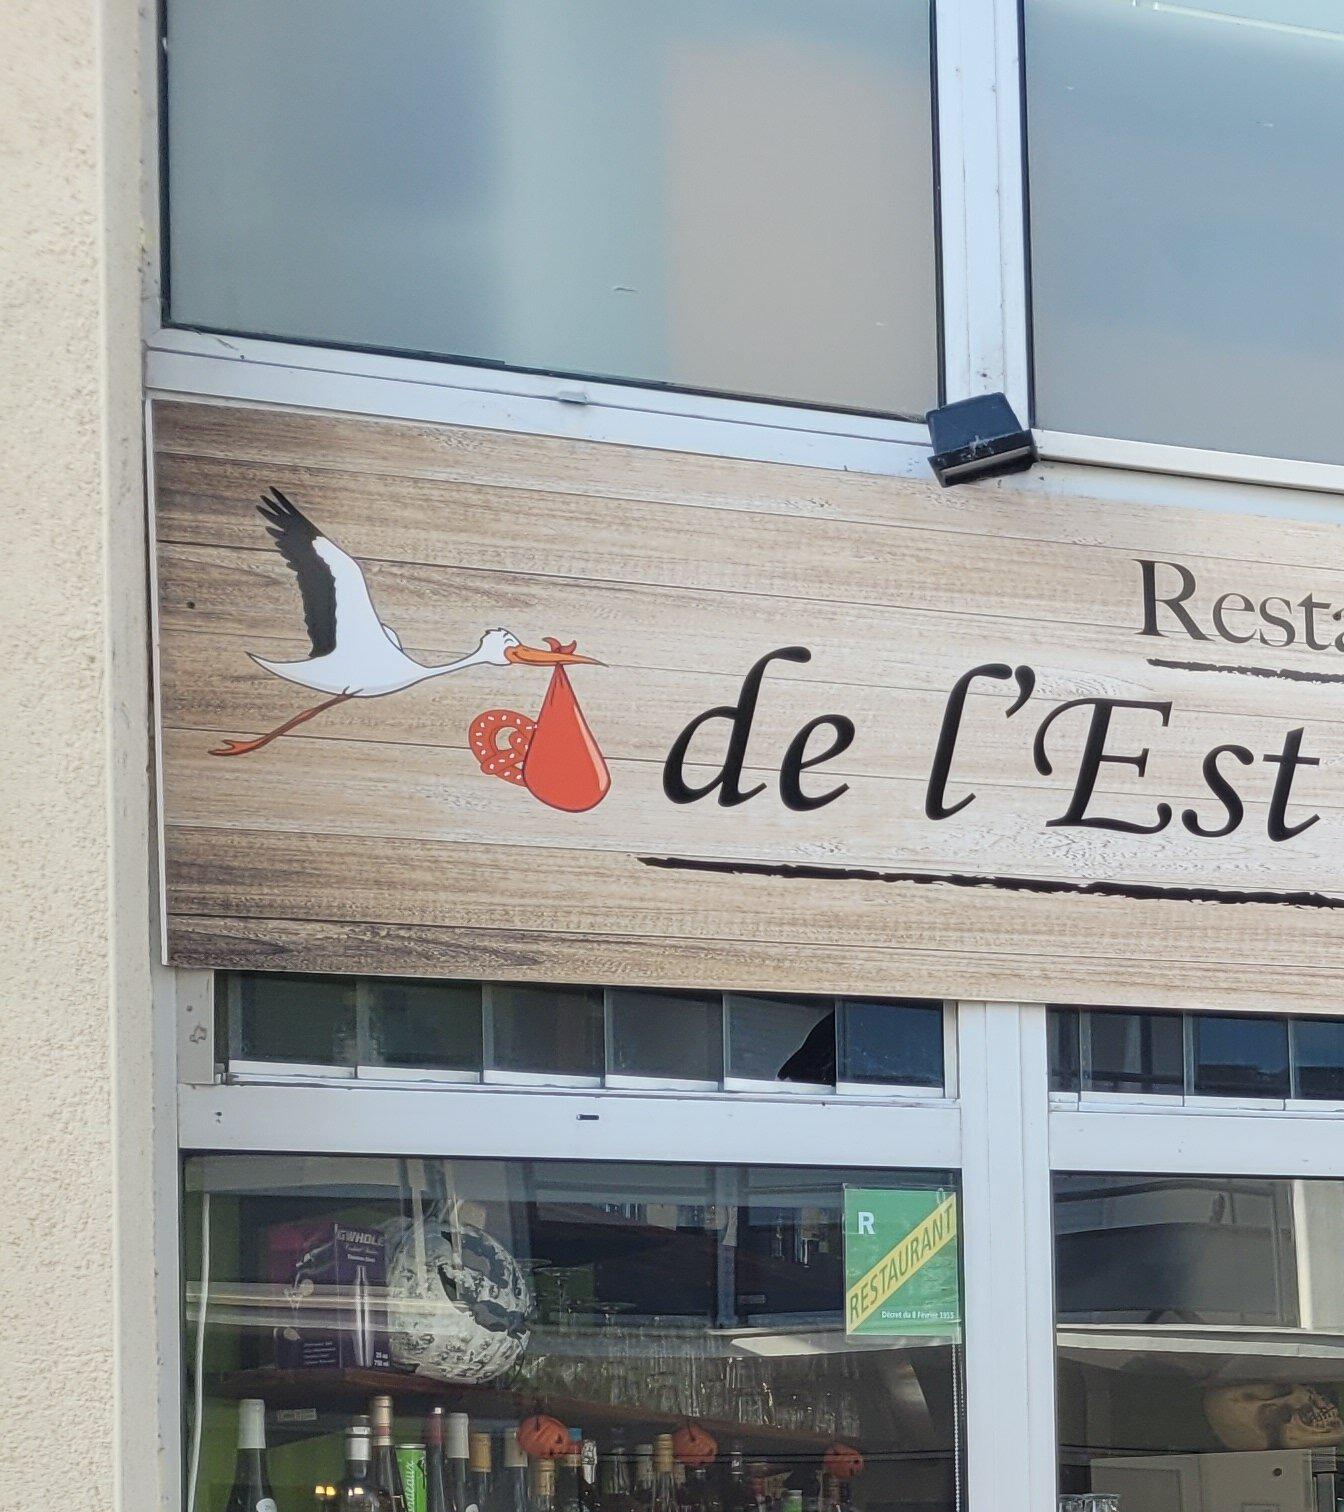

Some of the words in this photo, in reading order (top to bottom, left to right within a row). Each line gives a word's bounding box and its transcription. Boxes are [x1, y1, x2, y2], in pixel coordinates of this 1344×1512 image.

[663, 646, 855, 811] de
[850, 1202, 953, 1326] RESTAURANT
[857, 1211, 876, 1235] R
